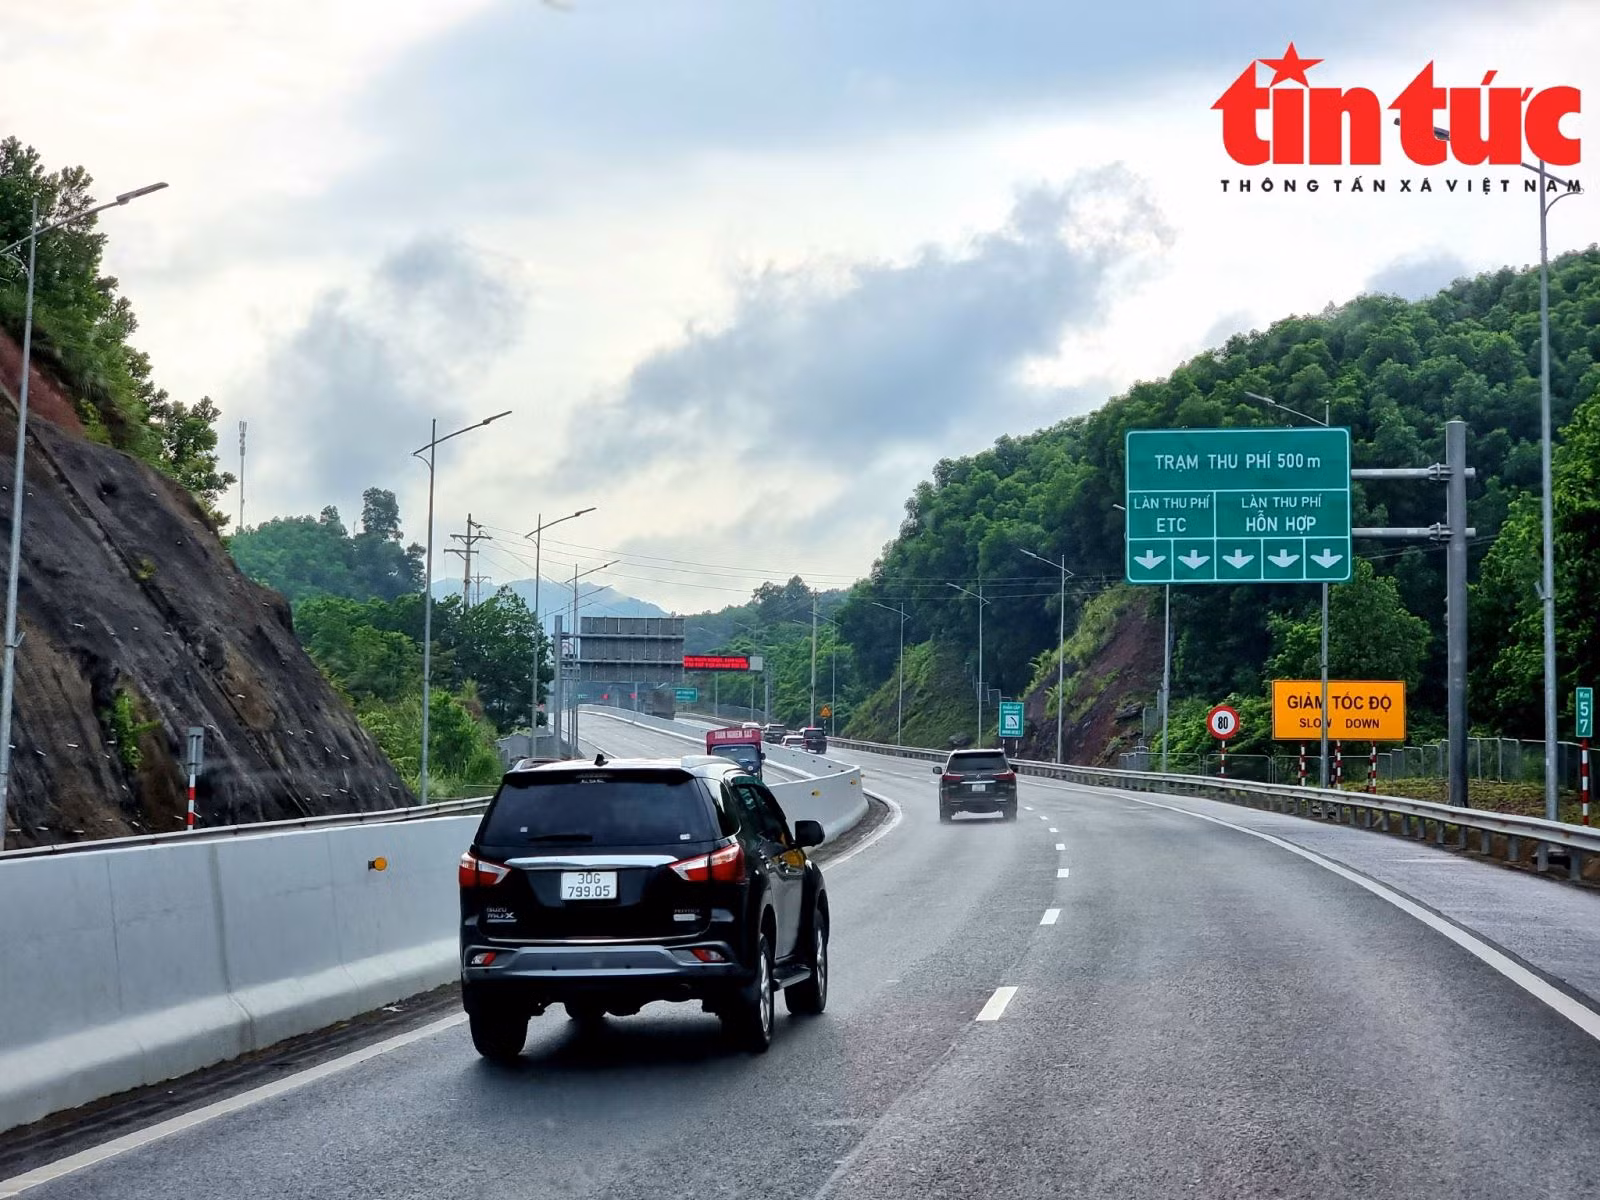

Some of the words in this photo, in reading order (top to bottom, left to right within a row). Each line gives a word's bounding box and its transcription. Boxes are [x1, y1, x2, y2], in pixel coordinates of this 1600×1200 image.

[1154, 454, 1199, 473] TRẠM
[1208, 453, 1238, 469] THU
[1246, 450, 1271, 469] PHÍ
[1277, 453, 1304, 469] 500
[1307, 456, 1321, 468] m
[1133, 495, 1159, 509] LÀN
[1162, 497, 1188, 509] THU
[1190, 494, 1211, 509] PHÍ
[1241, 494, 1268, 508] LÀN
[1273, 496, 1297, 508] THU
[1301, 493, 1322, 507] PHÍ
[1156, 517, 1187, 533] ETC
[1245, 510, 1278, 532] HỖN
[1285, 514, 1317, 534] HỢP
[1287, 691, 1326, 709] GIẢM
[1332, 691, 1364, 710] TỐC
[1368, 693, 1392, 712] ĐỘ
[1217, 716, 1229, 730] 80
[1345, 718, 1380, 729] DOWN
[577, 873, 601, 885] 30G
[567, 885, 610, 898] 799.05
